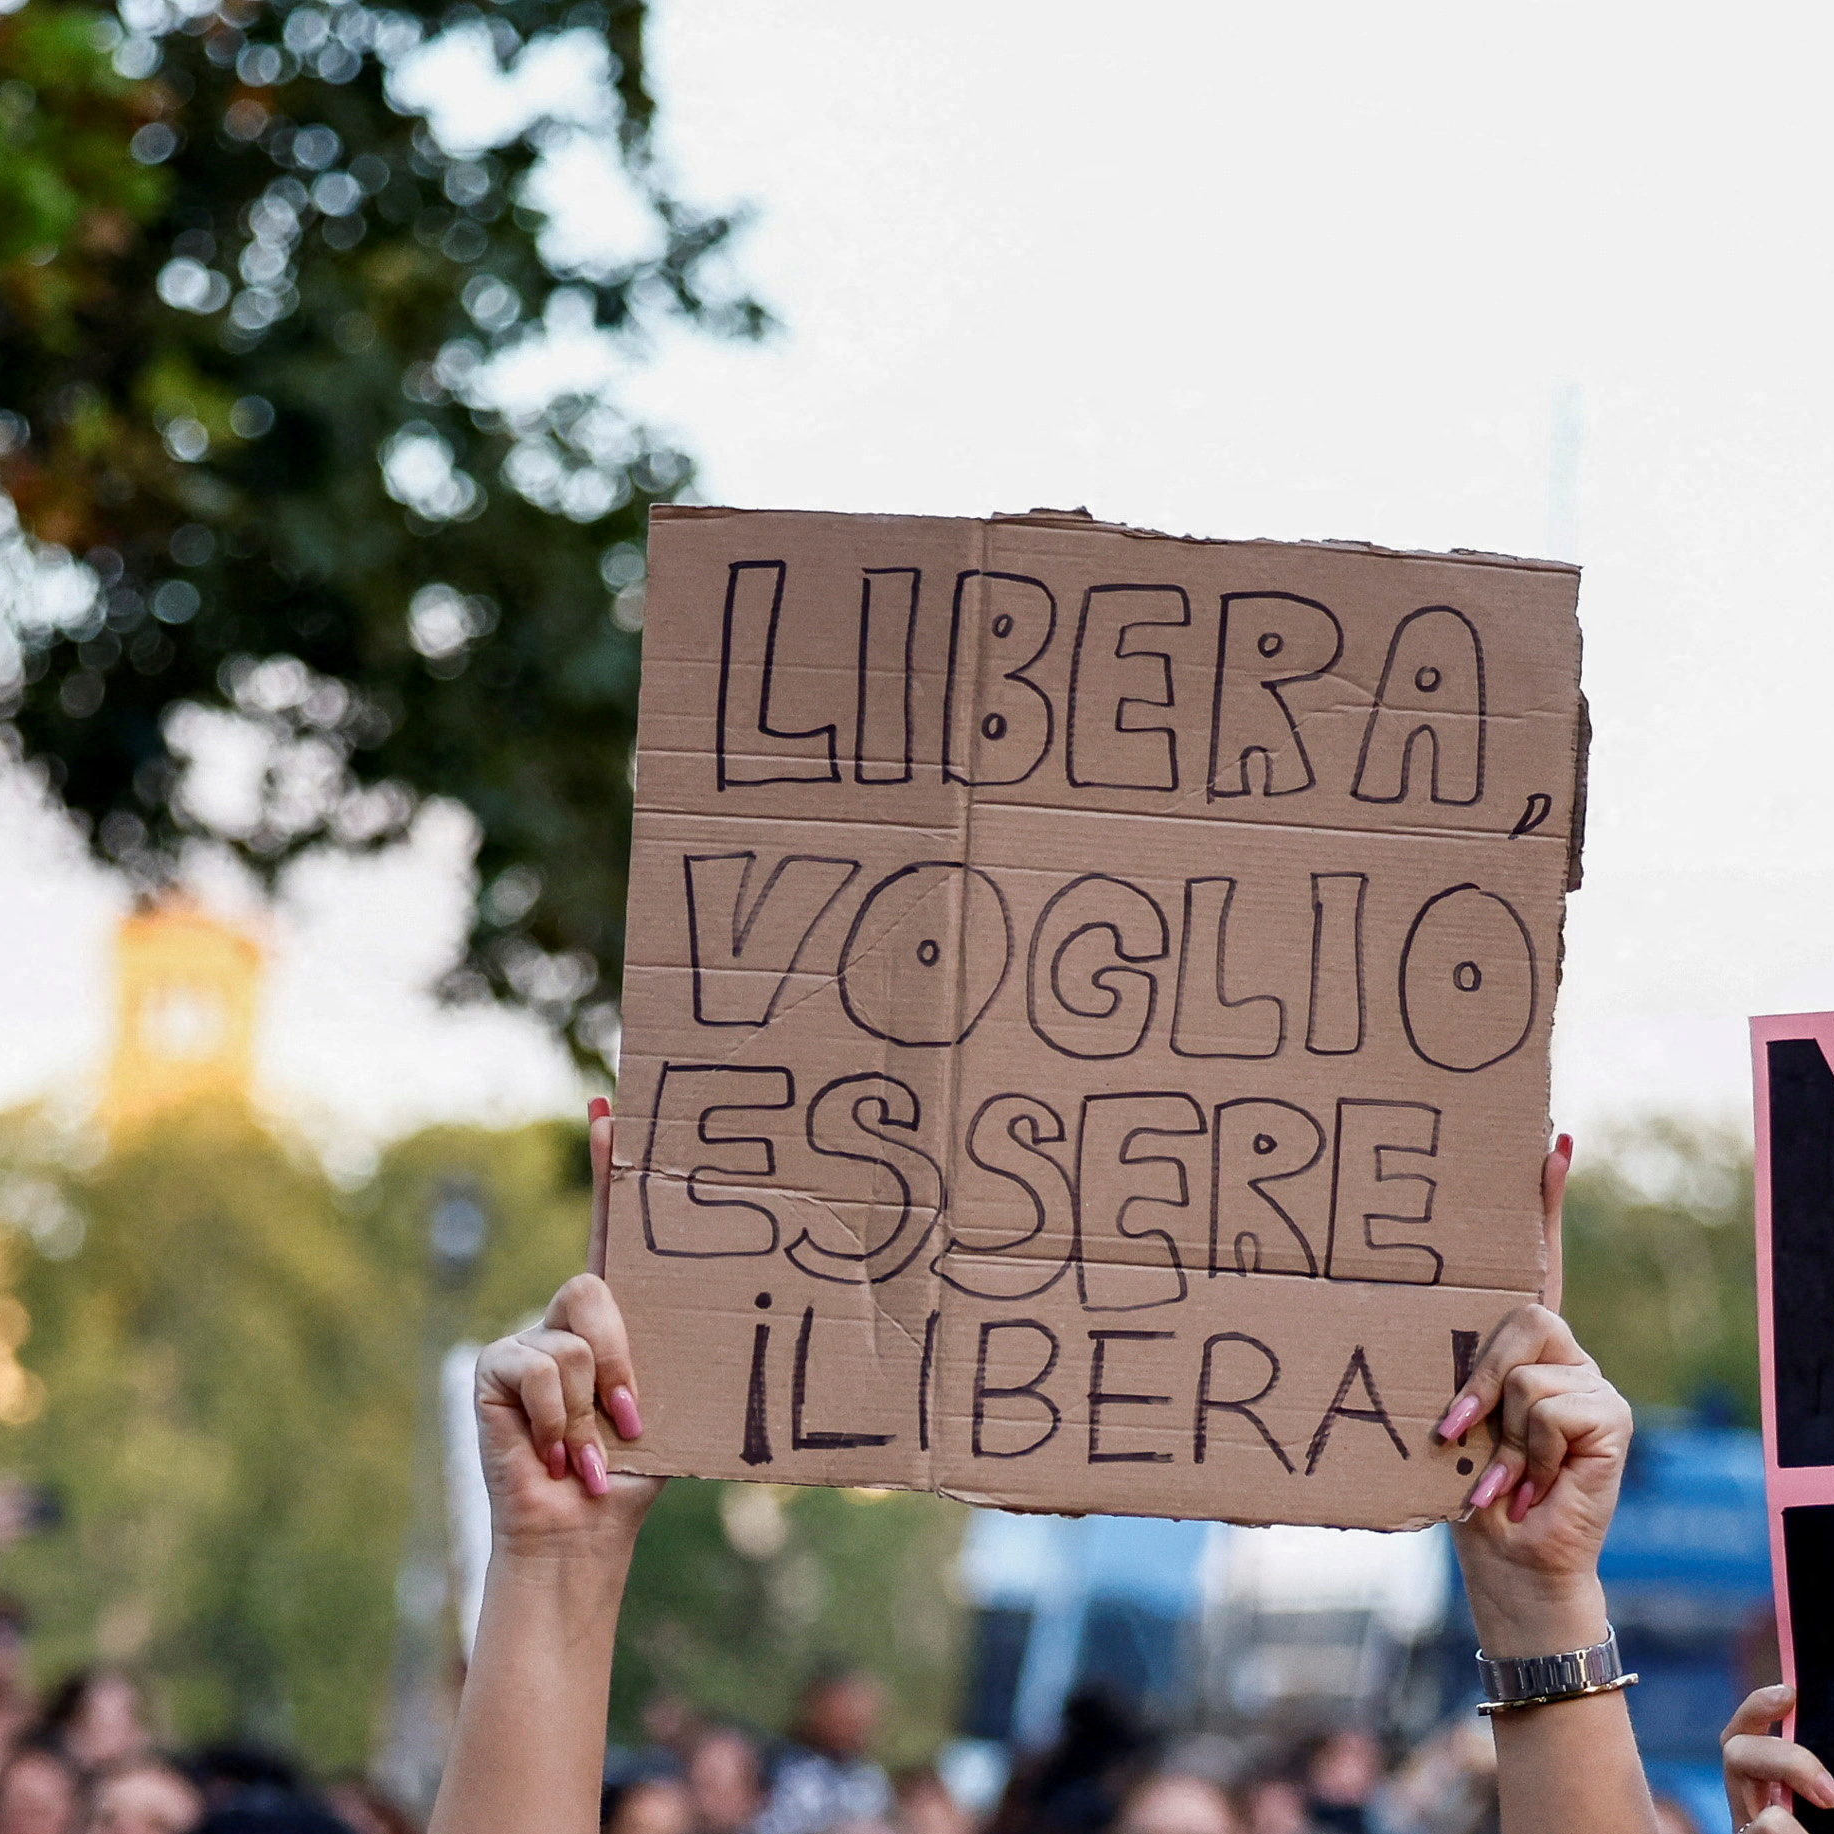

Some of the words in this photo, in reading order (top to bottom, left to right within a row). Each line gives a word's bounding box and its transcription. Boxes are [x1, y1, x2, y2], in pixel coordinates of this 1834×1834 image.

[716, 559, 1553, 841] LIBERA,
[684, 850, 1538, 1073] VOGLIO
[641, 1061, 1443, 1310] ESSERE
